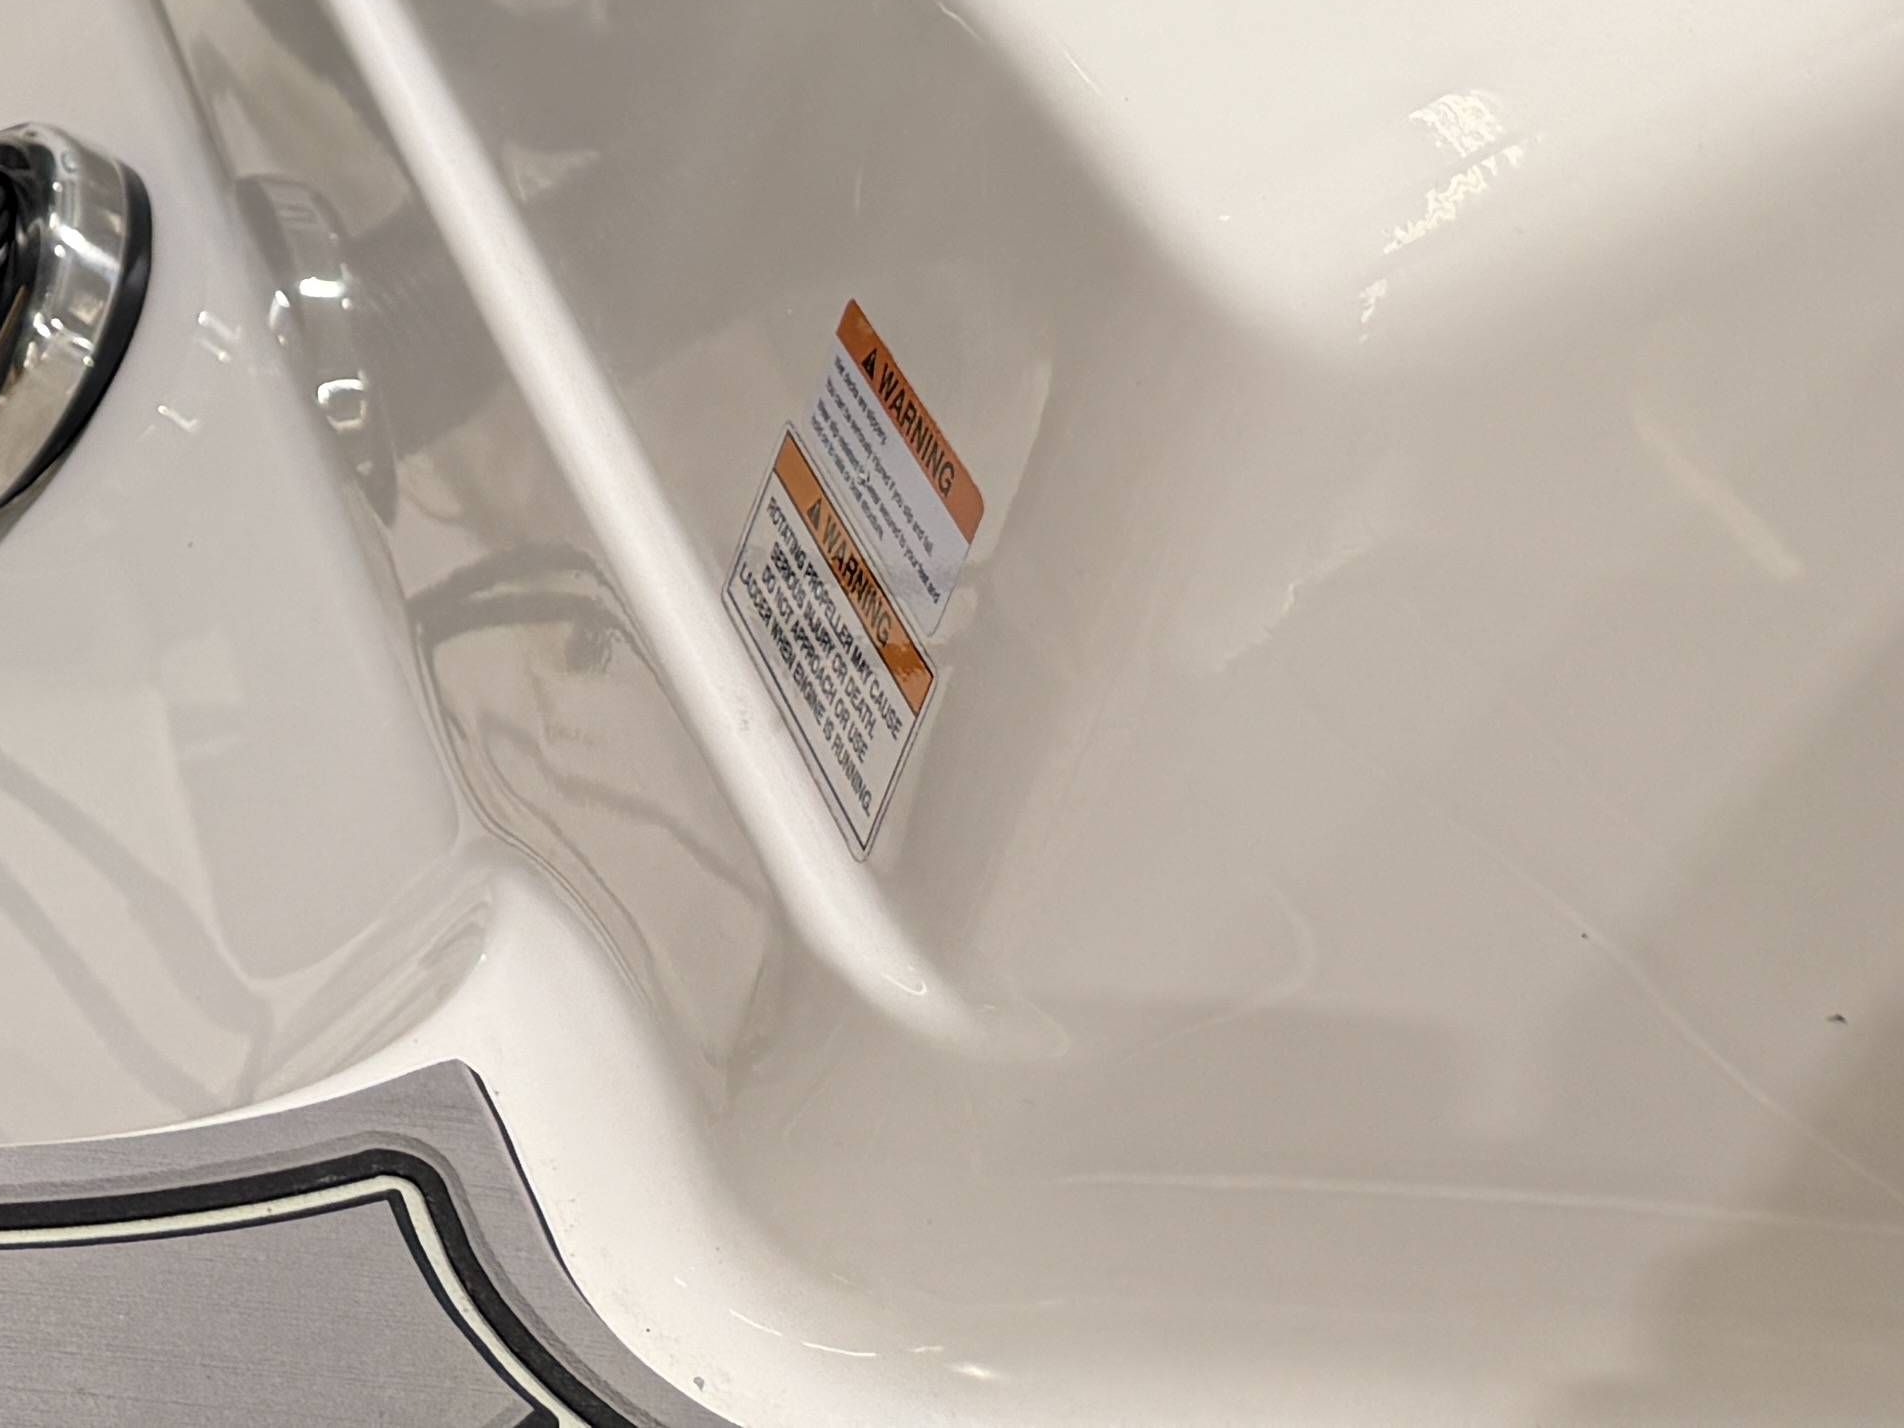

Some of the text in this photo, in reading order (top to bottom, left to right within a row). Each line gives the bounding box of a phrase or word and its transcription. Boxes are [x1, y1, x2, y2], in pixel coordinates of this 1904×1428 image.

[873, 360, 958, 499] WARNING
[738, 560, 773, 628] LADDER
[768, 616, 796, 672] WHEN
[791, 659, 827, 727] ENGINE
[821, 715, 835, 744] IS
[765, 492, 903, 742] ROTATING PROPELLER MAY CAUSE
[768, 538, 807, 612] SERIOUS
[802, 597, 836, 662] INJURY
[829, 648, 849, 687] OR
[818, 511, 895, 650] WARNING
[760, 562, 869, 766] DO NOT APPROACH OR USE
